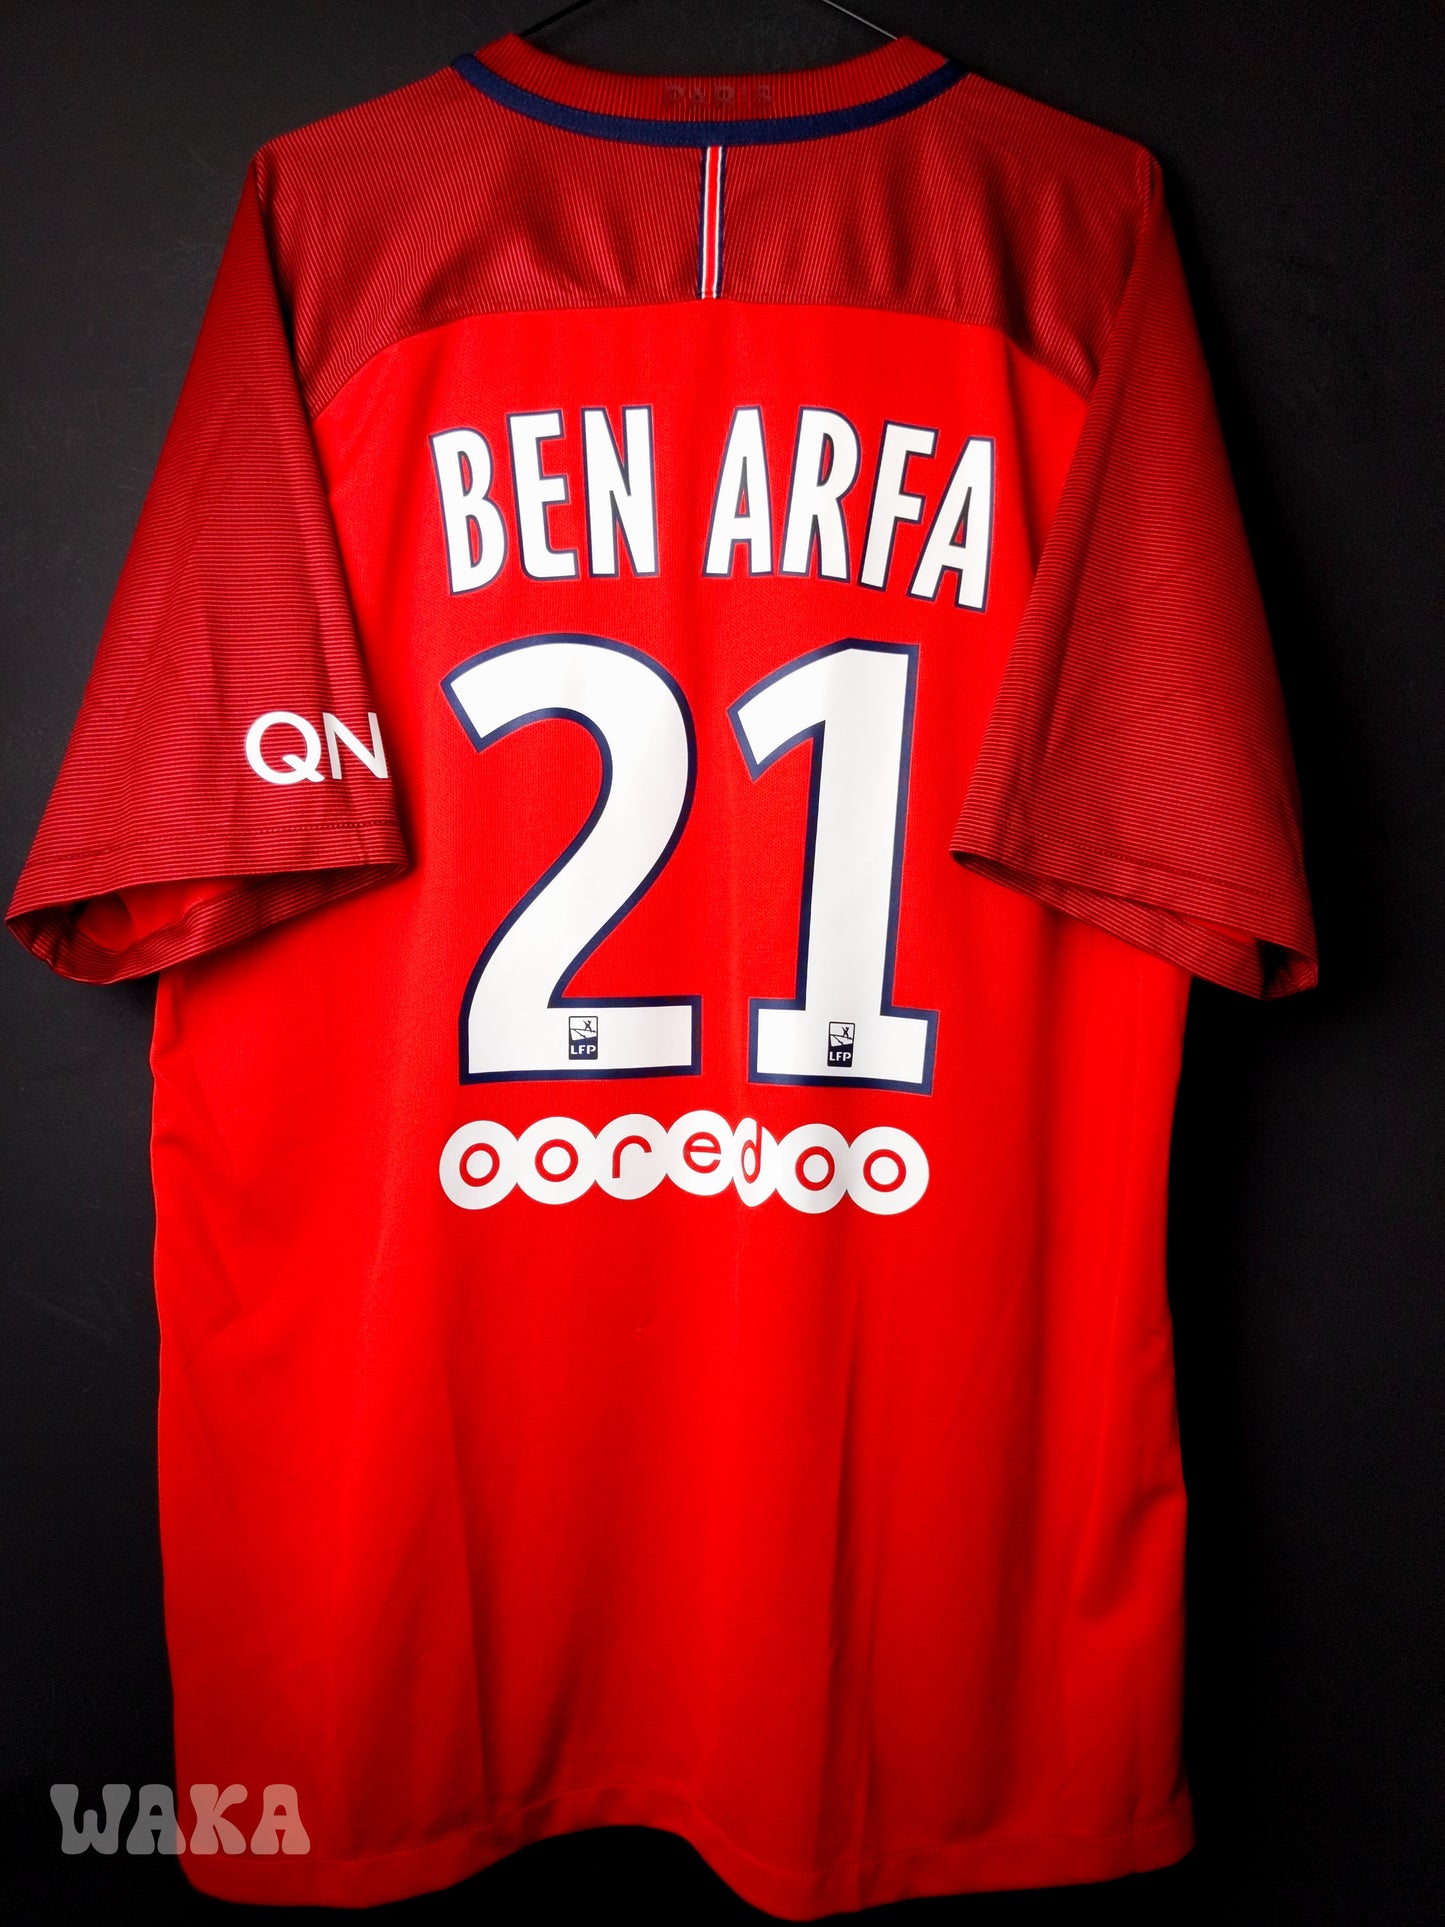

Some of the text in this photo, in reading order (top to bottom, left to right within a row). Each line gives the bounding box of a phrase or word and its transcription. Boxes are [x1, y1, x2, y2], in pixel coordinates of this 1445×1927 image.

[429, 405, 995, 613] BEN ARFA
[441, 632, 940, 1095] 21
[570, 1044, 597, 1055] LFP
[829, 1051, 851, 1062] LFP
[439, 1110, 930, 1215] ooredoo
